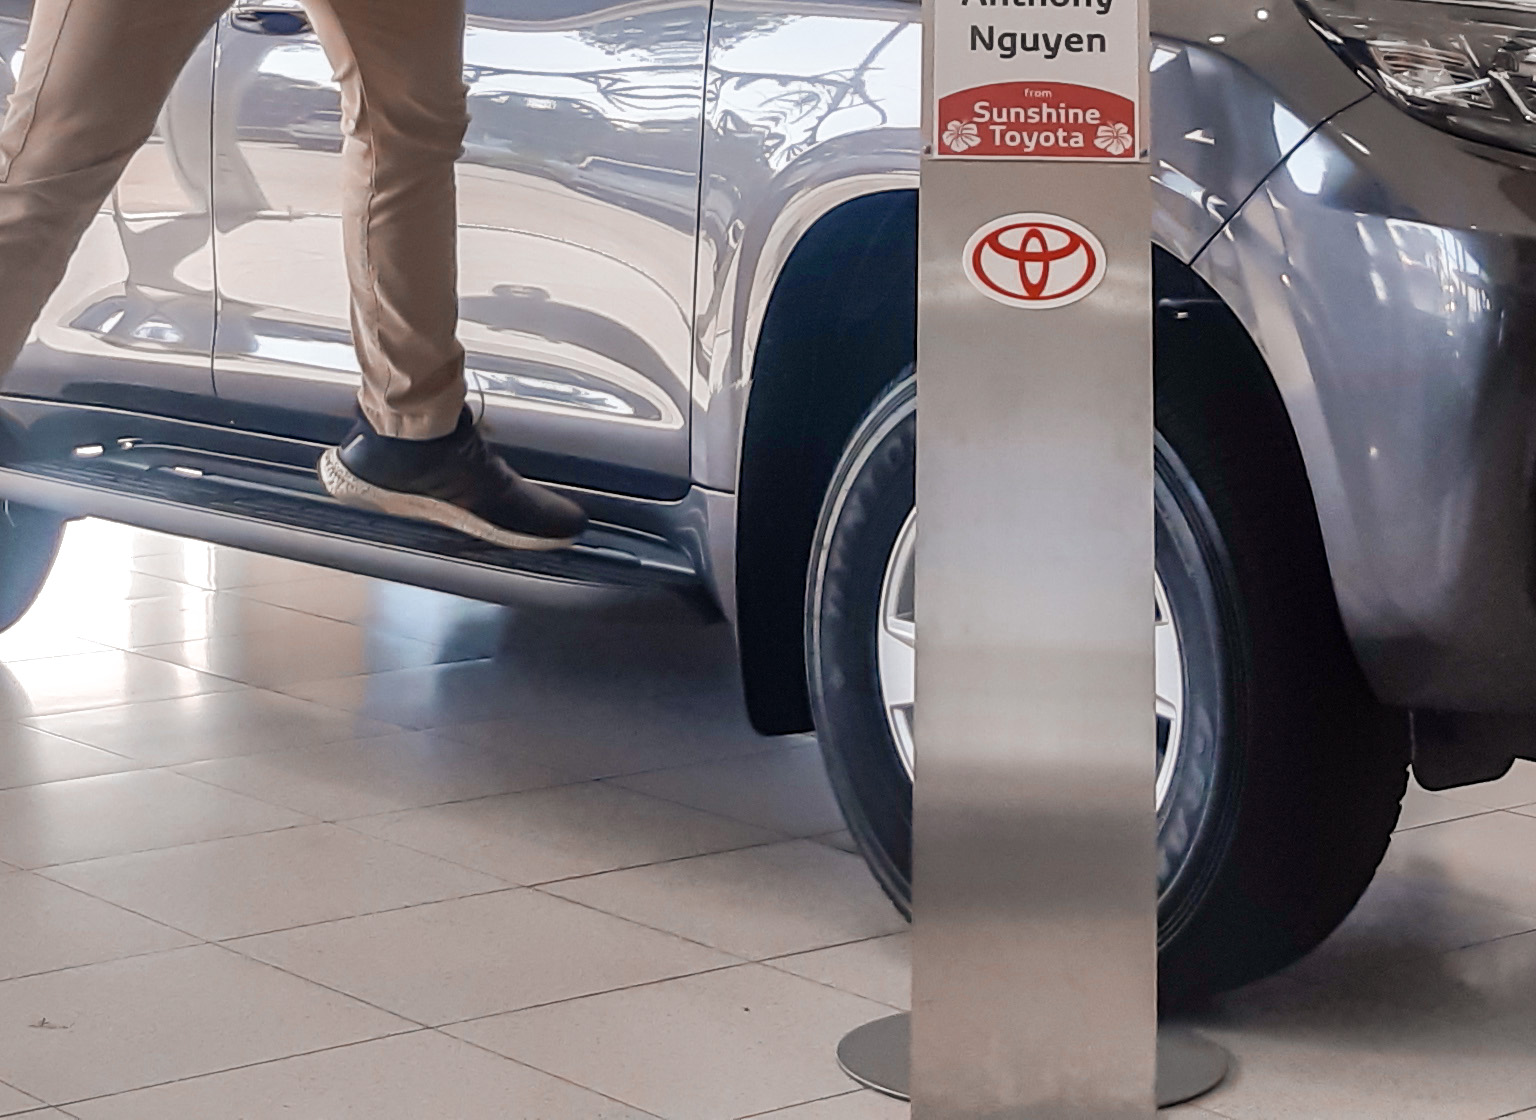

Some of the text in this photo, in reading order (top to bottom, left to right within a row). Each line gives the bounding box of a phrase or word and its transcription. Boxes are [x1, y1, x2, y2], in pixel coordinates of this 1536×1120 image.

[970, 24, 1107, 60] Nguyen
[1024, 87, 1053, 99] from
[972, 100, 1102, 125] Sunshine
[988, 124, 1084, 153] Toyota
